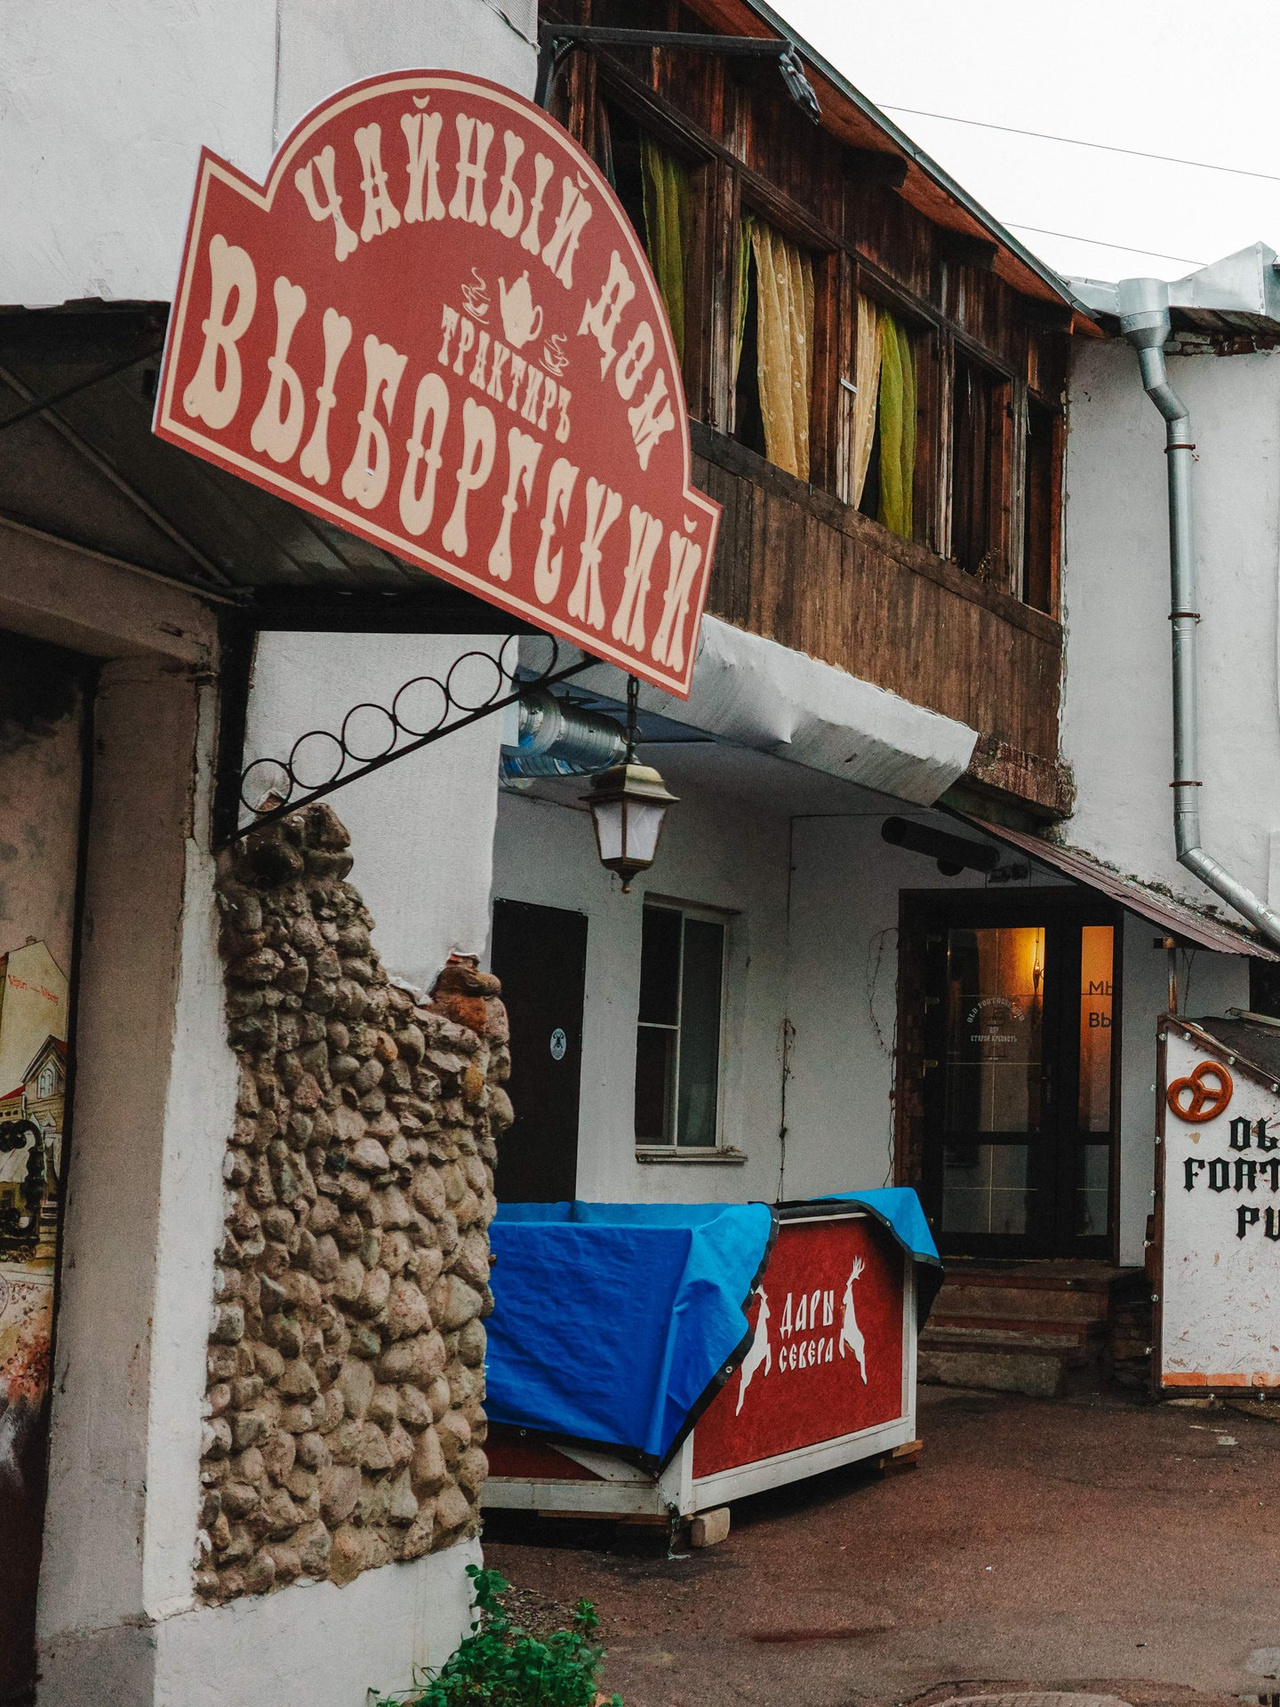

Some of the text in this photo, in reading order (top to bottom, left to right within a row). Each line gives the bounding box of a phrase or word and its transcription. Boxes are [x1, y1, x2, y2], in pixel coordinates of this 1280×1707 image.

[295, 95, 676, 471] ЧАЙНЫЙ ДОМ
[438, 304, 573, 444] ТРАКТИРЪ
[183, 233, 702, 673] ВЫБОРГСКИЙ
[967, 1007, 979, 1023] OLD
[778, 1337, 834, 1374] СЕВЕРА
[779, 1289, 835, 1340] ДАРЫ
